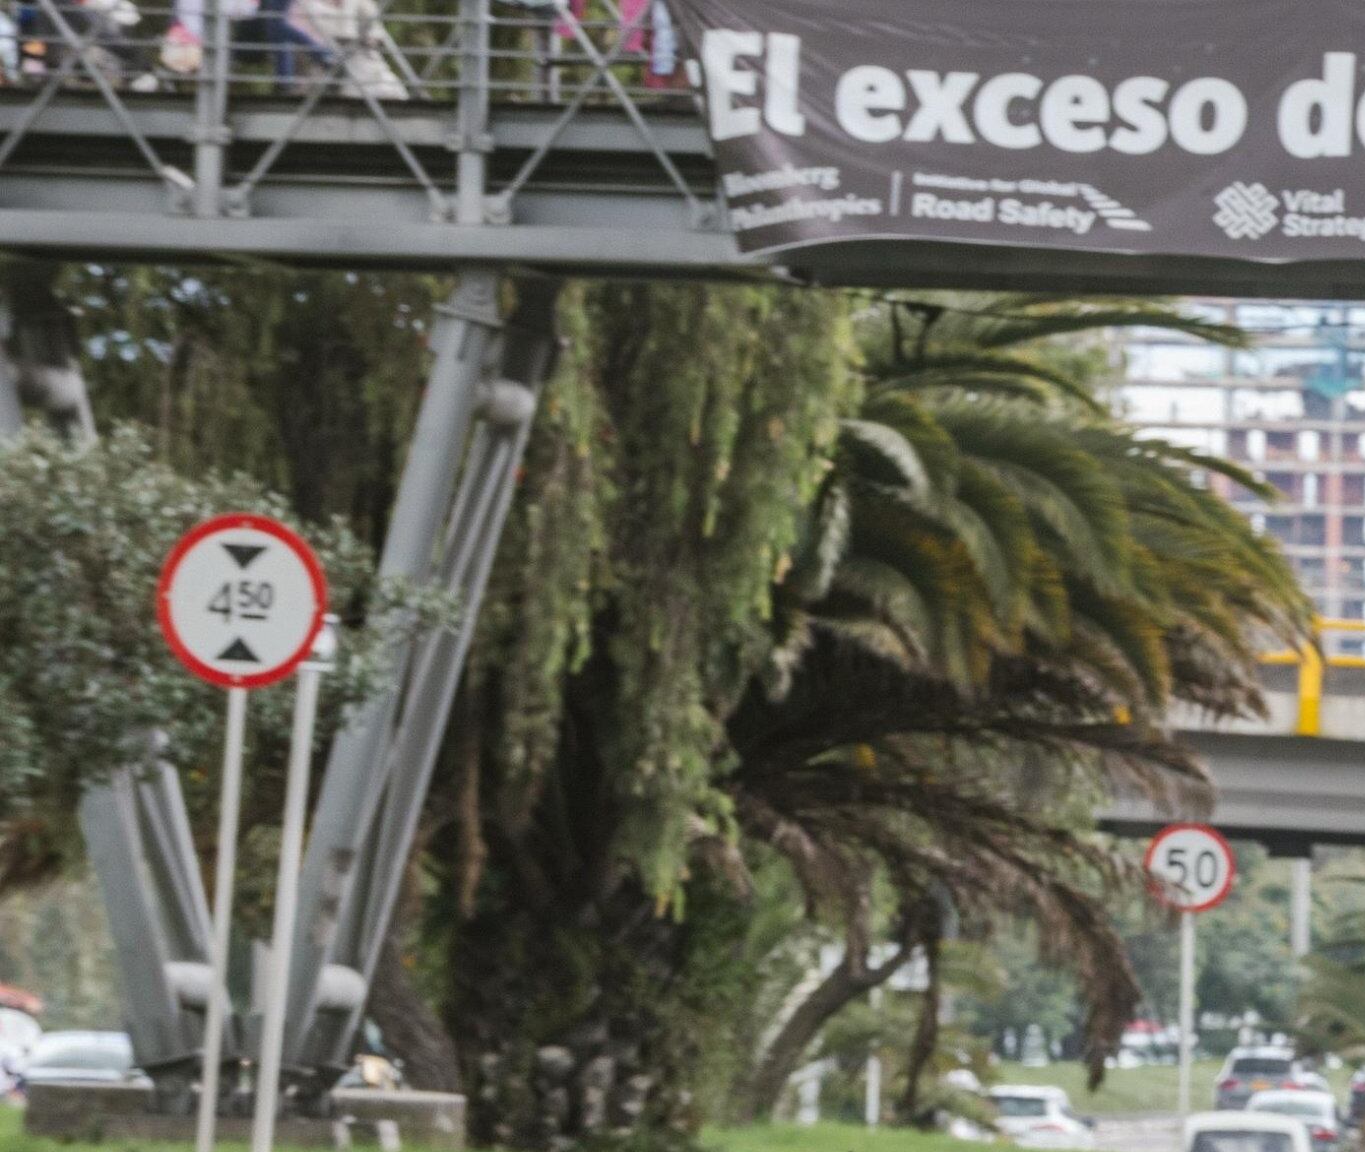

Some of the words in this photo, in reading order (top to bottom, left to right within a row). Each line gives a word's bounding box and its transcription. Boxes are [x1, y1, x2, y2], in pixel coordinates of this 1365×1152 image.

[701, 28, 803, 141] El
[835, 65, 1248, 153] exceso
[912, 192, 994, 222] Road
[997, 198, 1097, 234] Safety
[1281, 189, 1345, 213] Vital
[1167, 848, 1218, 888] 50
